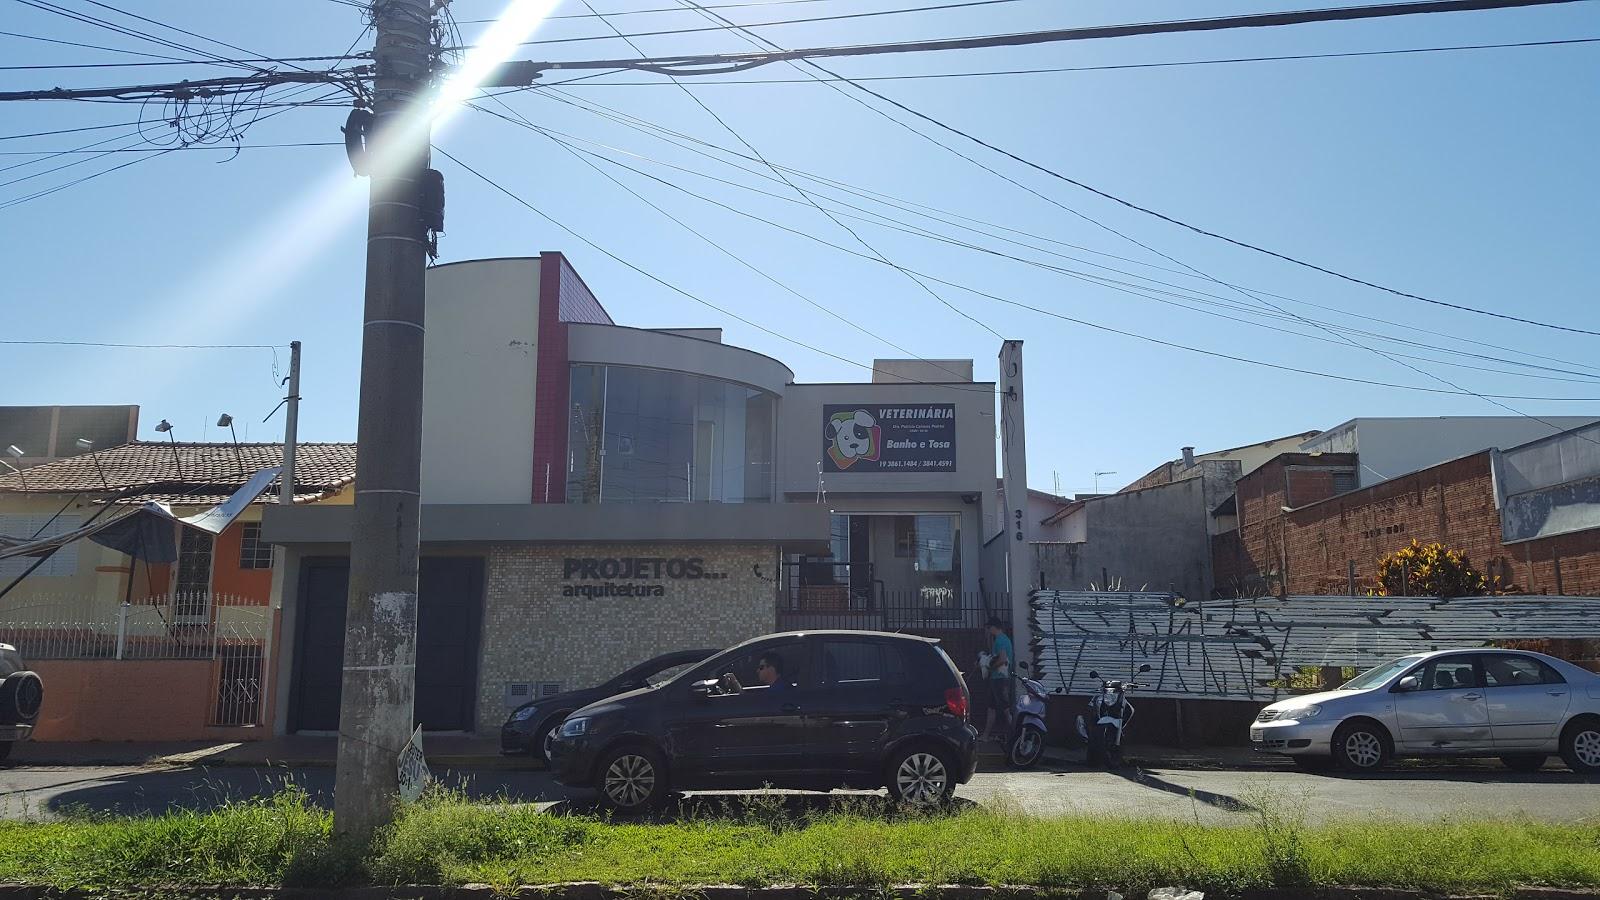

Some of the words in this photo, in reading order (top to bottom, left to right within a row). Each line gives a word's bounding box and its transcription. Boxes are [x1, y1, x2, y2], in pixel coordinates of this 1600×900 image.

[879, 406, 953, 419] VETERINÁRIA
[886, 438, 917, 449] Banho
[919, 441, 926, 449] e
[928, 439, 951, 449] Tosa
[1015, 509, 1023, 541] 316
[563, 557, 728, 580] PROJETOS...
[562, 581, 665, 600] arquitetura
